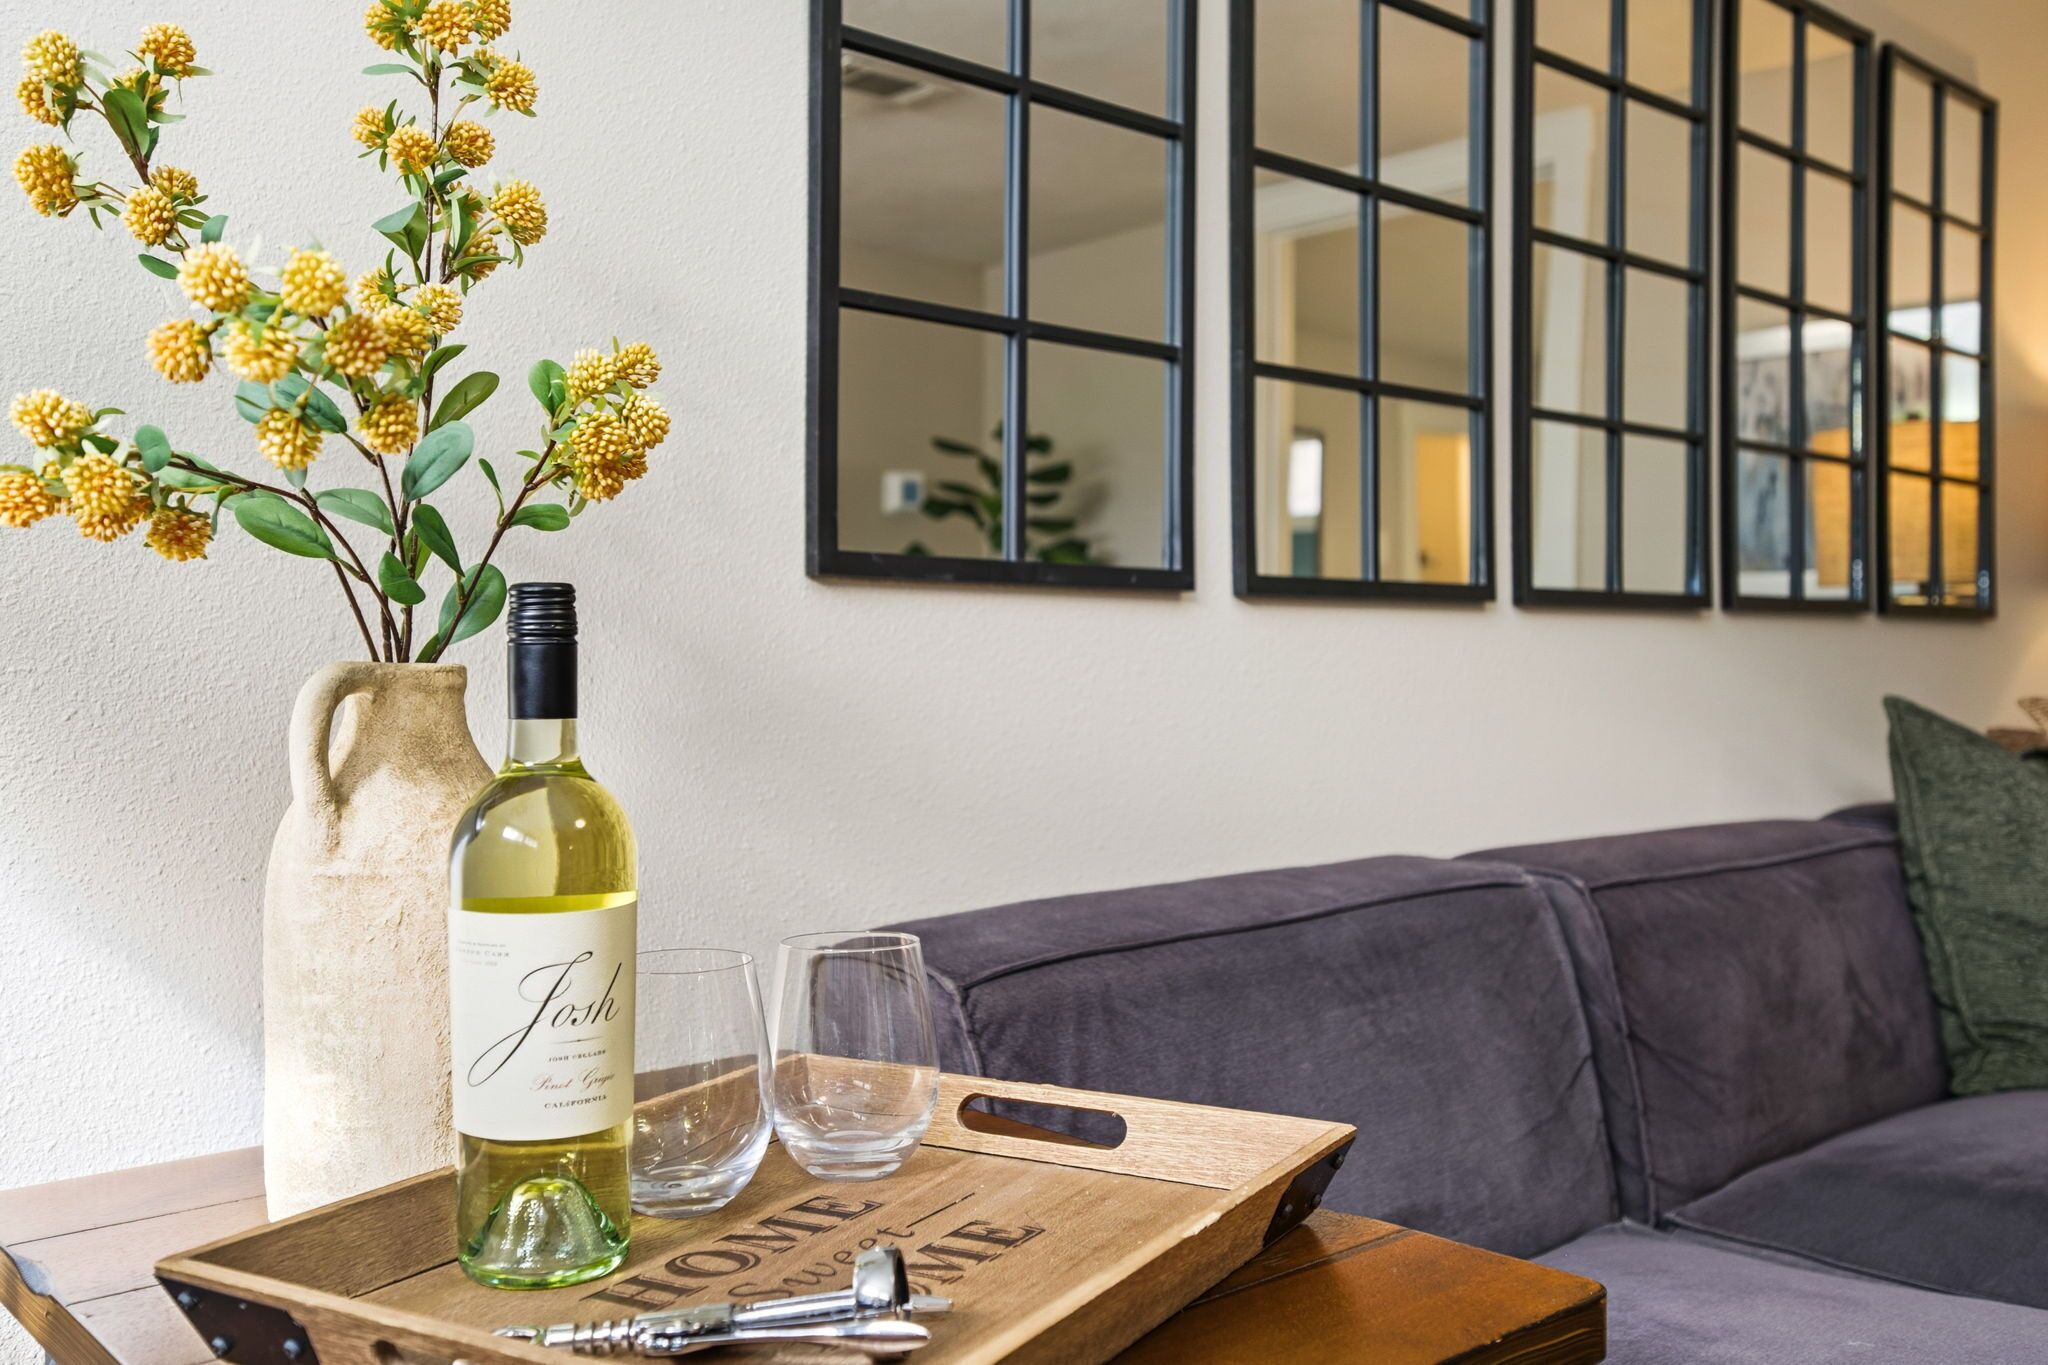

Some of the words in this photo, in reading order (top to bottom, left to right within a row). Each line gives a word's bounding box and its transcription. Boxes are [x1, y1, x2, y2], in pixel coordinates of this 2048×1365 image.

[467, 951, 622, 1087] Josh
[544, 1094, 608, 1110] CALIFORNIA
[579, 1194, 884, 1311] HOME
